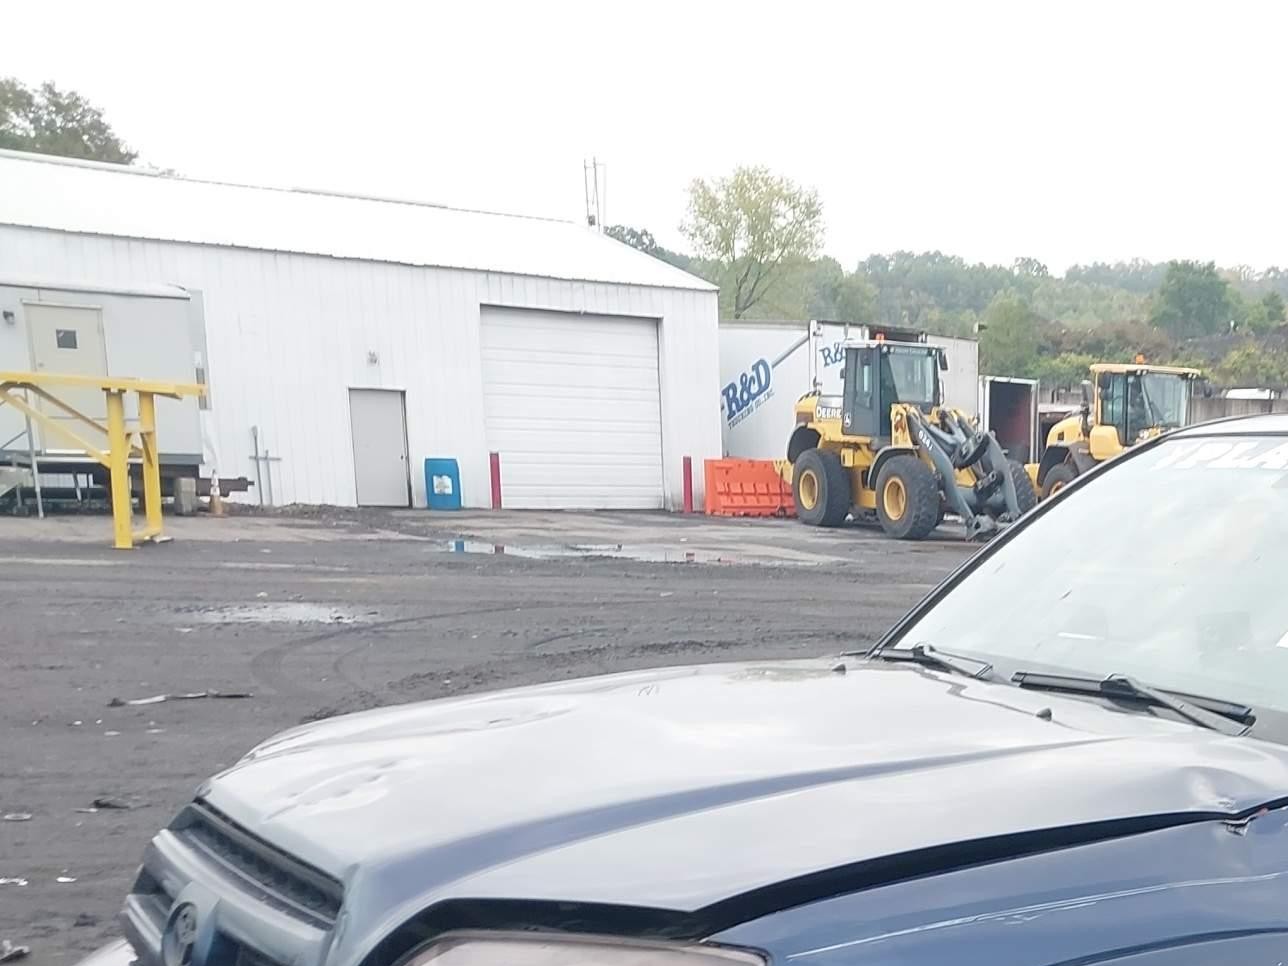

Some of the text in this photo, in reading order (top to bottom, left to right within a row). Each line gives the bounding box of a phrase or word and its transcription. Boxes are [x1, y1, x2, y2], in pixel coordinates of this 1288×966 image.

[818, 342, 845, 367] R&
[722, 358, 772, 422] R&D
[816, 407, 843, 420] DEERE
